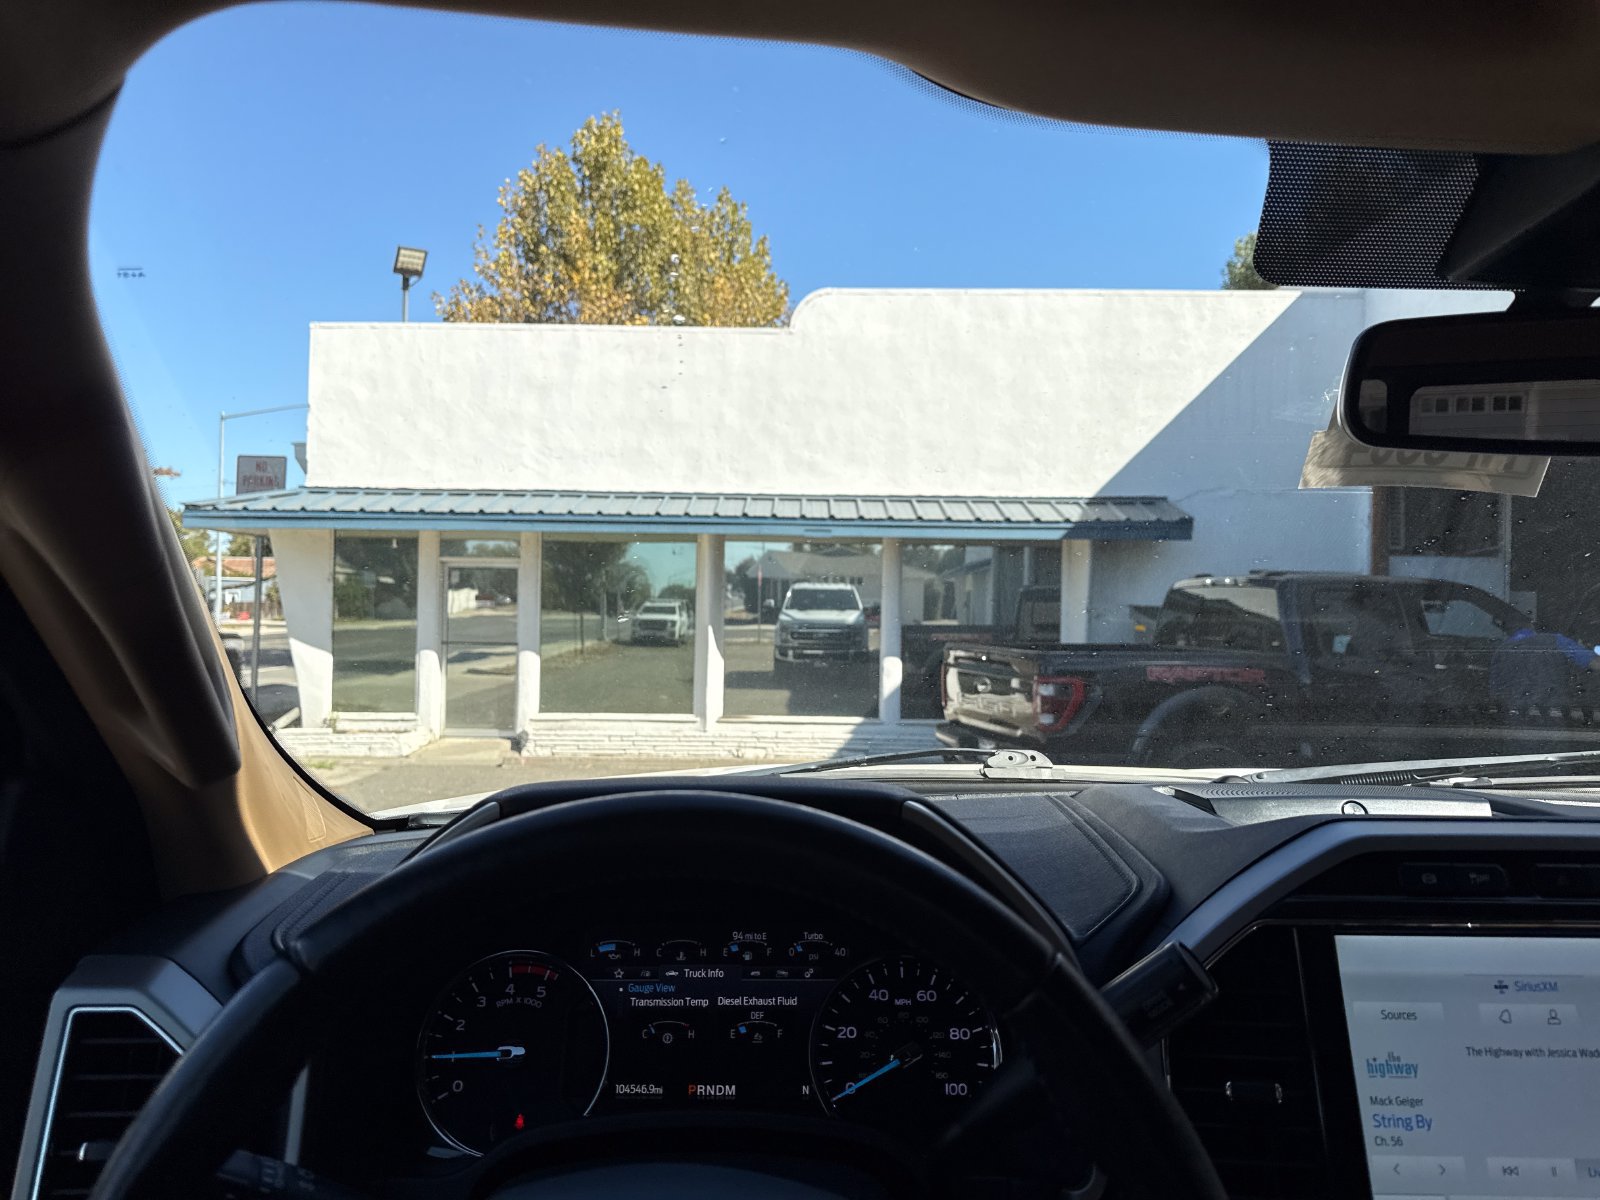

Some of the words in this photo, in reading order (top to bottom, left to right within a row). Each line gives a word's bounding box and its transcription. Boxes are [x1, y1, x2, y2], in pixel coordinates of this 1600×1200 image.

[732, 931, 743, 941] 94
[803, 931, 824, 941] Turbo
[633, 947, 640, 957] H
[656, 947, 662, 957] C
[699, 947, 707, 957] H
[723, 947, 729, 957] E
[766, 947, 772, 957] F
[808, 952, 819, 961] psi
[834, 947, 846, 957] 40
[683, 968, 706, 978] Truck
[708, 968, 724, 978] Info
[505, 984, 516, 995] 4
[536, 986, 547, 998] 5
[628, 983, 654, 993] Gauge
[655, 983, 676, 993] View
[1514, 981, 1558, 992] SiriusXM
[868, 989, 889, 1001] 40
[916, 989, 937, 1002] 60
[476, 996, 487, 1008] 3
[495, 998, 514, 1008] RPM
[523, 997, 543, 1009] 1000
[630, 997, 684, 1007] Transmission
[685, 997, 709, 1007] Temp
[717, 996, 742, 1006] Diesel
[743, 997, 776, 1006] Exhaust
[777, 996, 798, 1006] Fluid
[894, 998, 911, 1006] MPH
[750, 1011, 764, 1020] DEF
[1380, 1010, 1418, 1021] Sources
[455, 1019, 466, 1031] 2
[642, 1029, 648, 1039] C
[687, 1029, 695, 1039] H
[730, 1029, 736, 1039] E
[777, 1029, 783, 1039] F
[836, 1026, 857, 1039] 20
[949, 1027, 970, 1040] 80
[1387, 1051, 1402, 1062] the
[1465, 1046, 1482, 1057] The
[1484, 1047, 1523, 1058] Highway
[1524, 1048, 1545, 1057] with
[1547, 1048, 1578, 1059] Jessica
[1366, 1057, 1419, 1079] highway
[452, 1080, 464, 1093] 0
[802, 1085, 810, 1096] N
[944, 1083, 968, 1096] 100
[1369, 1096, 1394, 1106] Mack
[1395, 1096, 1424, 1109] Geiger
[1372, 1113, 1414, 1132] String
[1415, 1114, 1433, 1132] By
[1374, 1135, 1390, 1147] Ch.
[1391, 1135, 1404, 1147] 56
